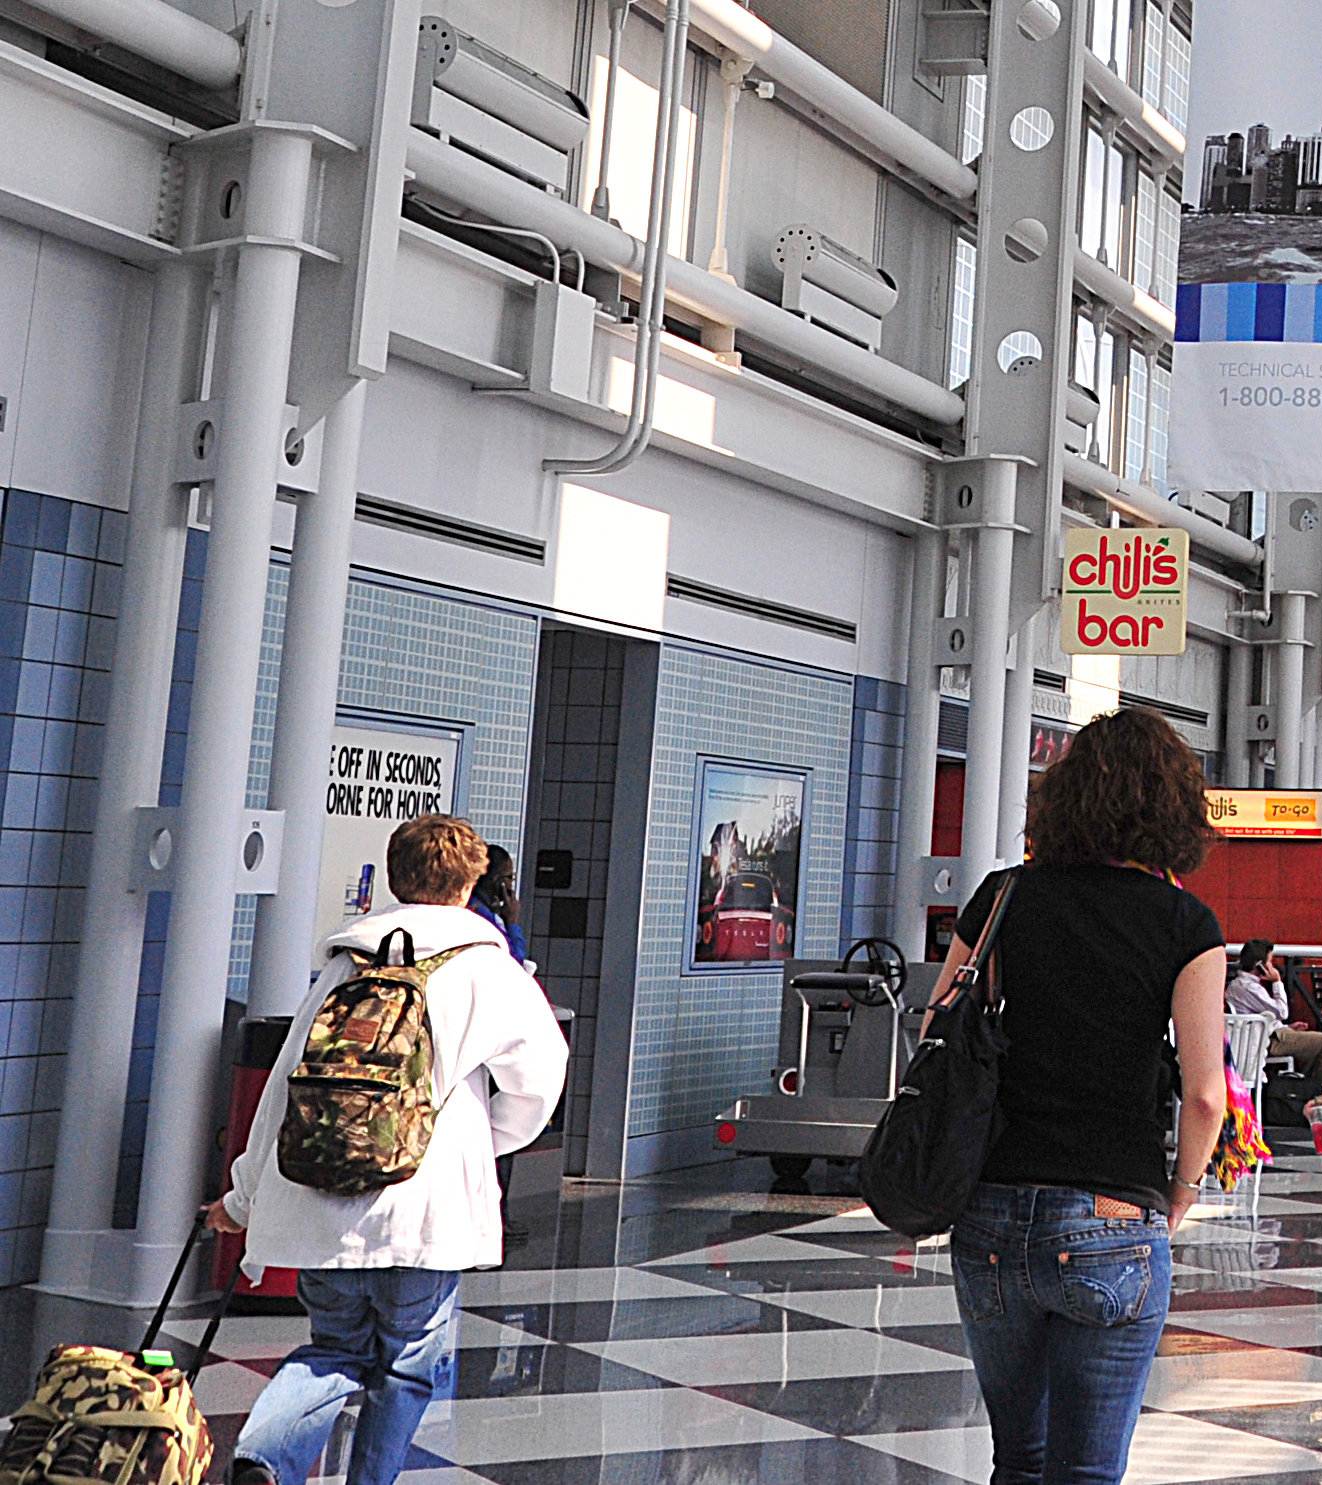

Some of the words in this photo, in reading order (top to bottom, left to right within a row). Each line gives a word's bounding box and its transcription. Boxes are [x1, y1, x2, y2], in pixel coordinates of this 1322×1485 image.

[1219, 362, 1314, 378] TECHNICAL
[1069, 535, 1178, 600] chili's
[1077, 598, 1164, 647] bar
[338, 746, 364, 779] OFF
[366, 749, 382, 781] IN
[385, 752, 442, 789] SECONDS,
[366, 787, 394, 820] FOR
